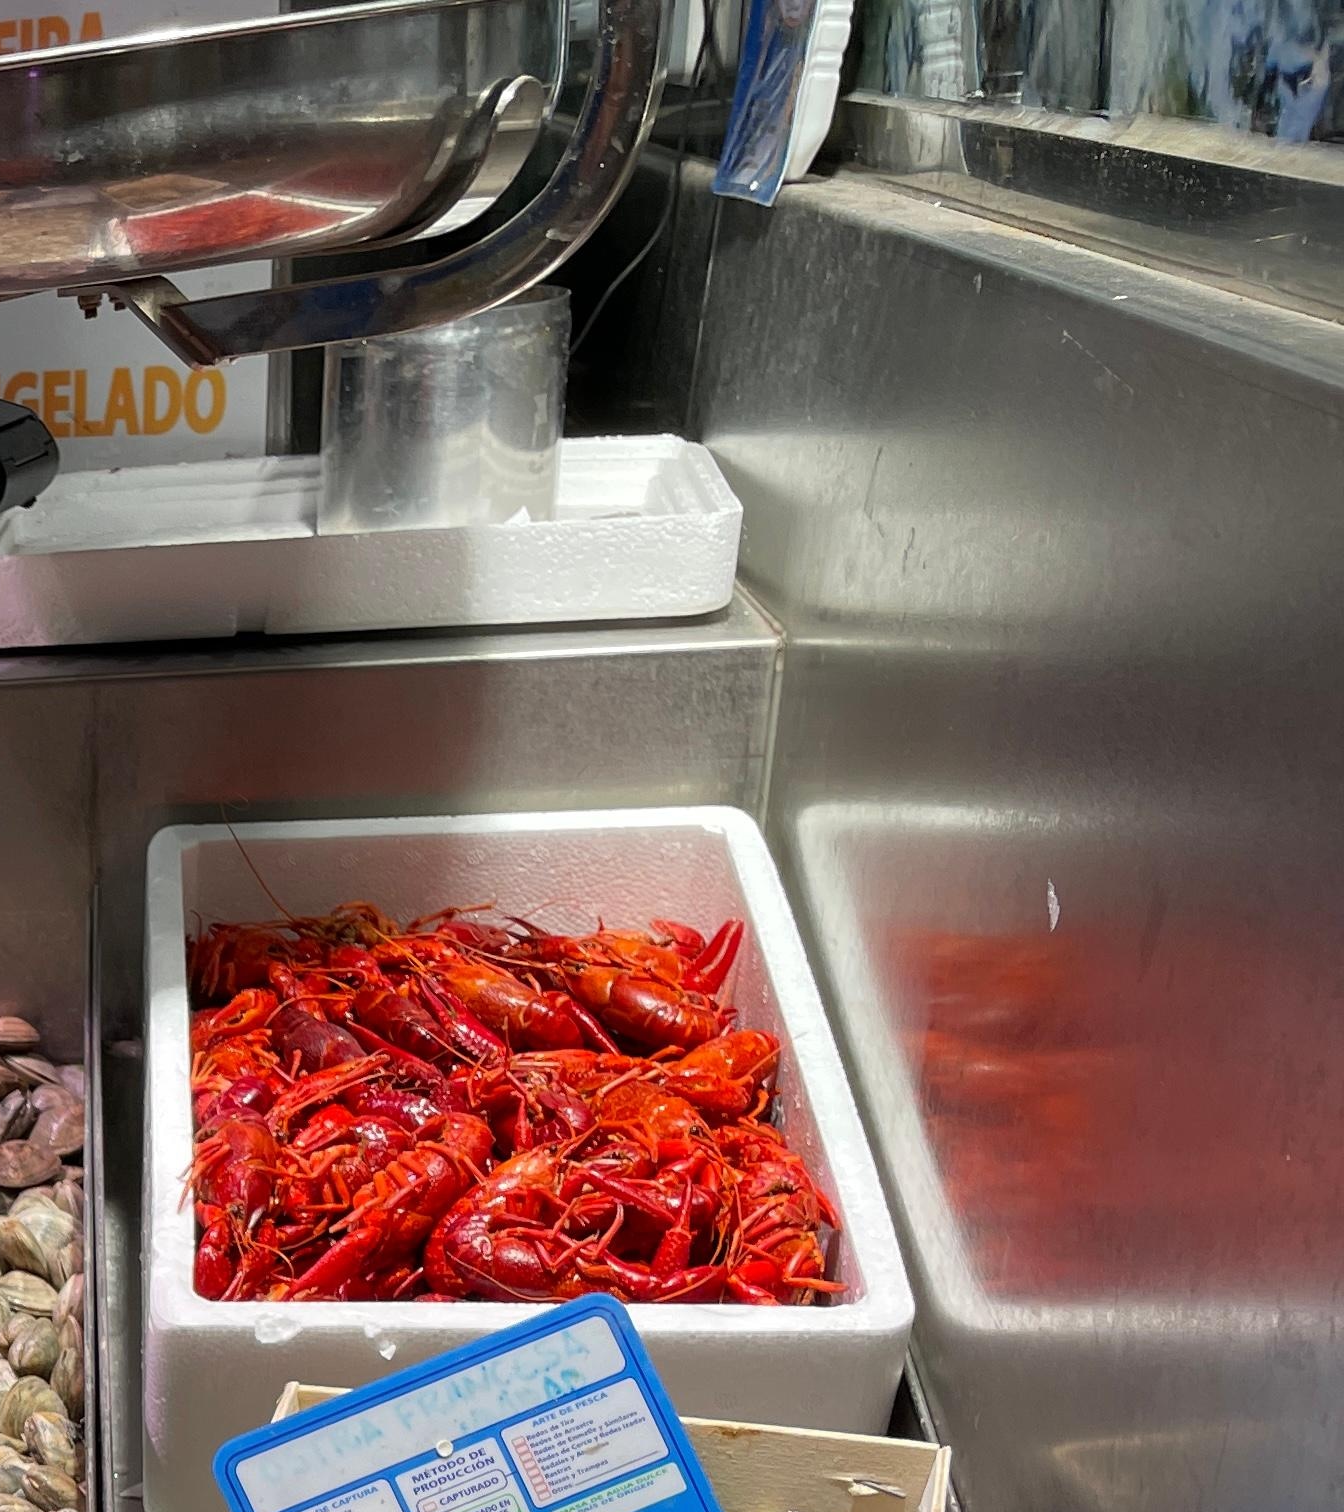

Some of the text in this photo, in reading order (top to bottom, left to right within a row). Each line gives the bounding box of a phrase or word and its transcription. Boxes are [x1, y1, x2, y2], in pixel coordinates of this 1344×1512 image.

[532, 1390, 609, 1427] ARTE DE PESCA
[469, 1446, 487, 1460] DE
[331, 1484, 379, 1510] CAPTURA
[438, 1474, 499, 1506] CAPTURADO
[497, 1497, 510, 1508] EN
